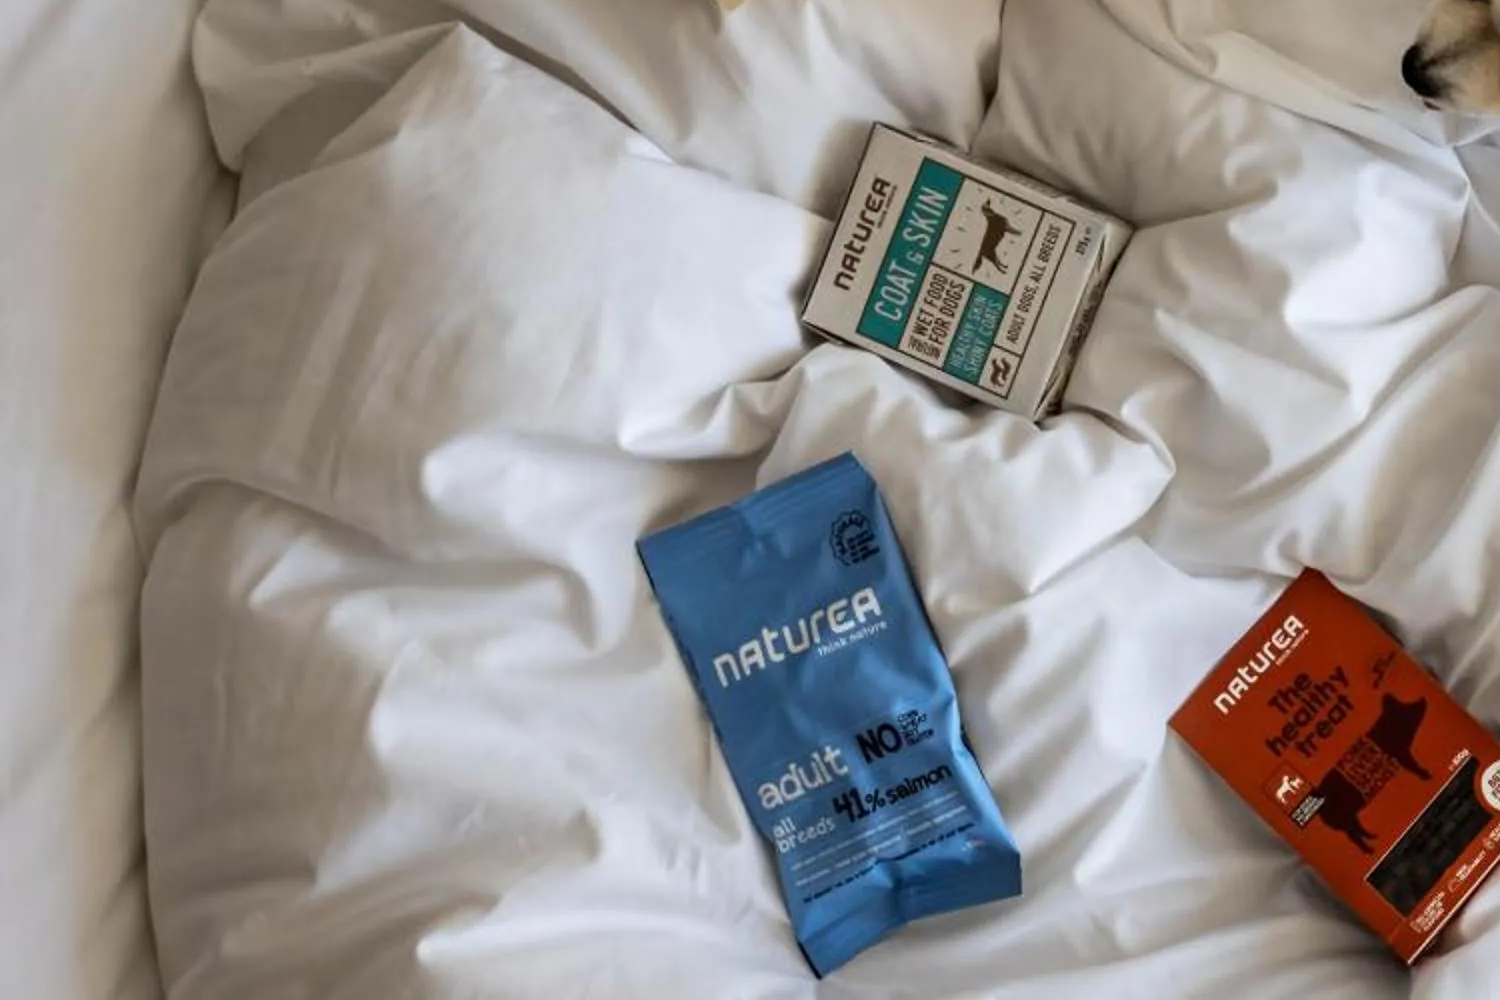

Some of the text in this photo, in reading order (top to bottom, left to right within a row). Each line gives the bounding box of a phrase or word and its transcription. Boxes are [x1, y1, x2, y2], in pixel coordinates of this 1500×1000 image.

[872, 257, 919, 321] COAT
[901, 184, 948, 248] SKIN
[912, 306, 934, 337] WET
[923, 271, 948, 308] FOOD
[928, 279, 965, 345] FOR DOGS
[1004, 312, 1025, 344] ADULT
[1027, 262, 1045, 284] ALL
[1266, 666, 1348, 756] healthy
[1268, 674, 1312, 714] The
[856, 724, 902, 763] NO
[1296, 695, 1354, 757] treat
[758, 746, 849, 808] adult
[832, 766, 952, 822] 41% salmon
[774, 817, 795, 838] all
[776, 818, 834, 853] breeds
